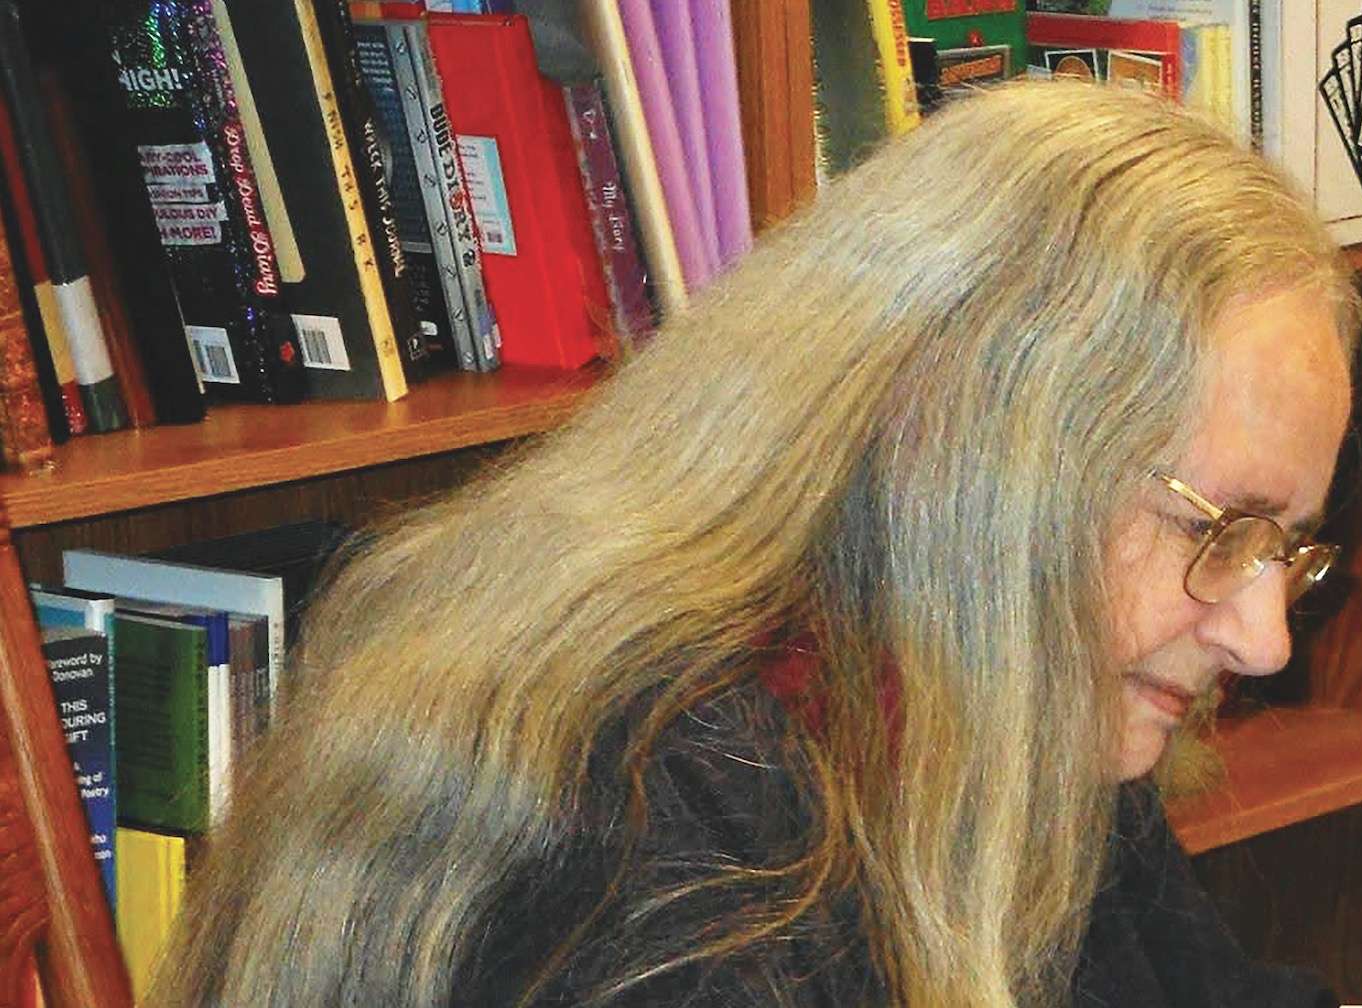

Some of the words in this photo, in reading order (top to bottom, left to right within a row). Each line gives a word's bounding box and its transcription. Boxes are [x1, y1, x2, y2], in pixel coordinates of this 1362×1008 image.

[430, 103, 454, 158] DUDE
[224, 125, 245, 173] Drop
[235, 177, 262, 228] Dead
[250, 231, 278, 295] Diary
[50, 653, 88, 670] oreword
[61, 699, 88, 713] THIS
[66, 730, 89, 743] IFT
